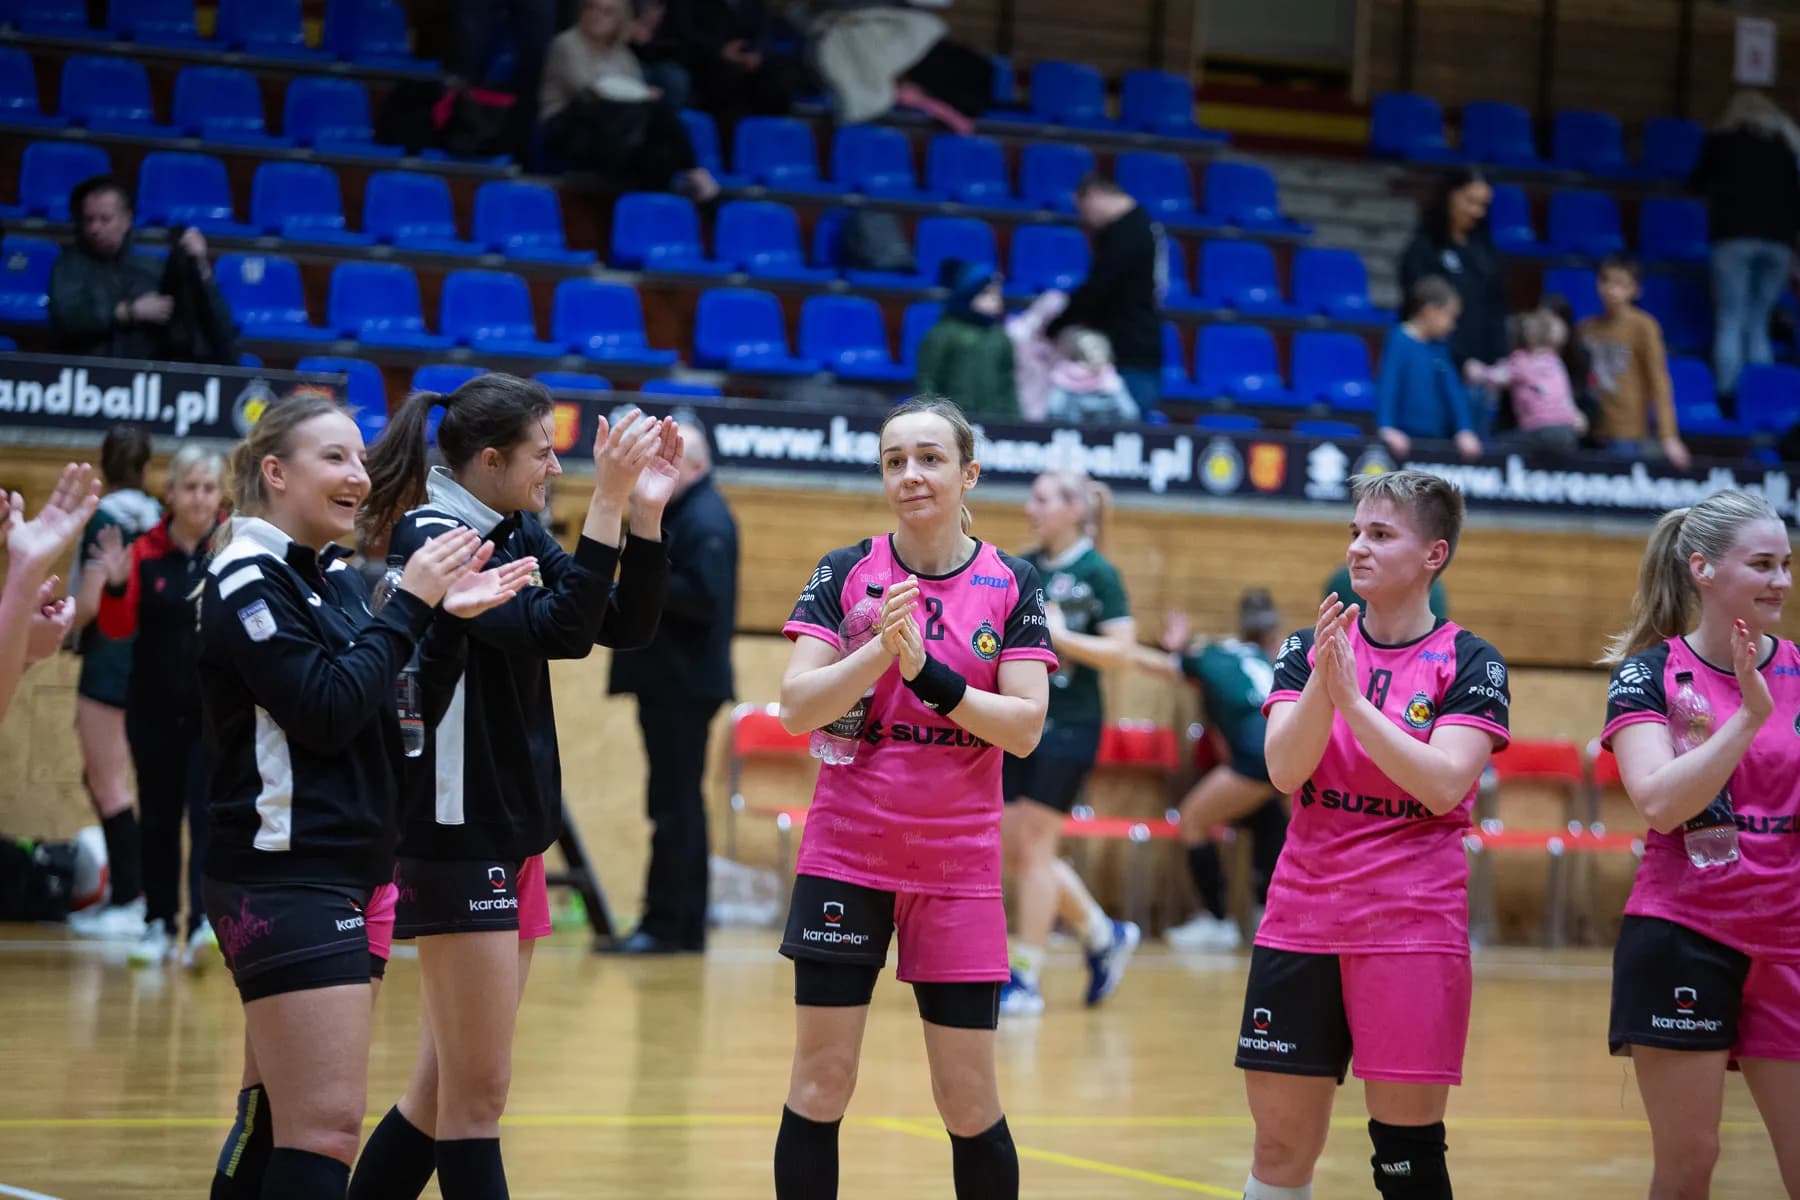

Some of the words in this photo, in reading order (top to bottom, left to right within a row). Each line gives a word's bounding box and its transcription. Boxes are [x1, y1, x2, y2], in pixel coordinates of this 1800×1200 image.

[970, 574, 1009, 589] Joma
[925, 597, 945, 641] 2
[802, 927, 862, 945] karabela
[1651, 1014, 1717, 1032] karabela
